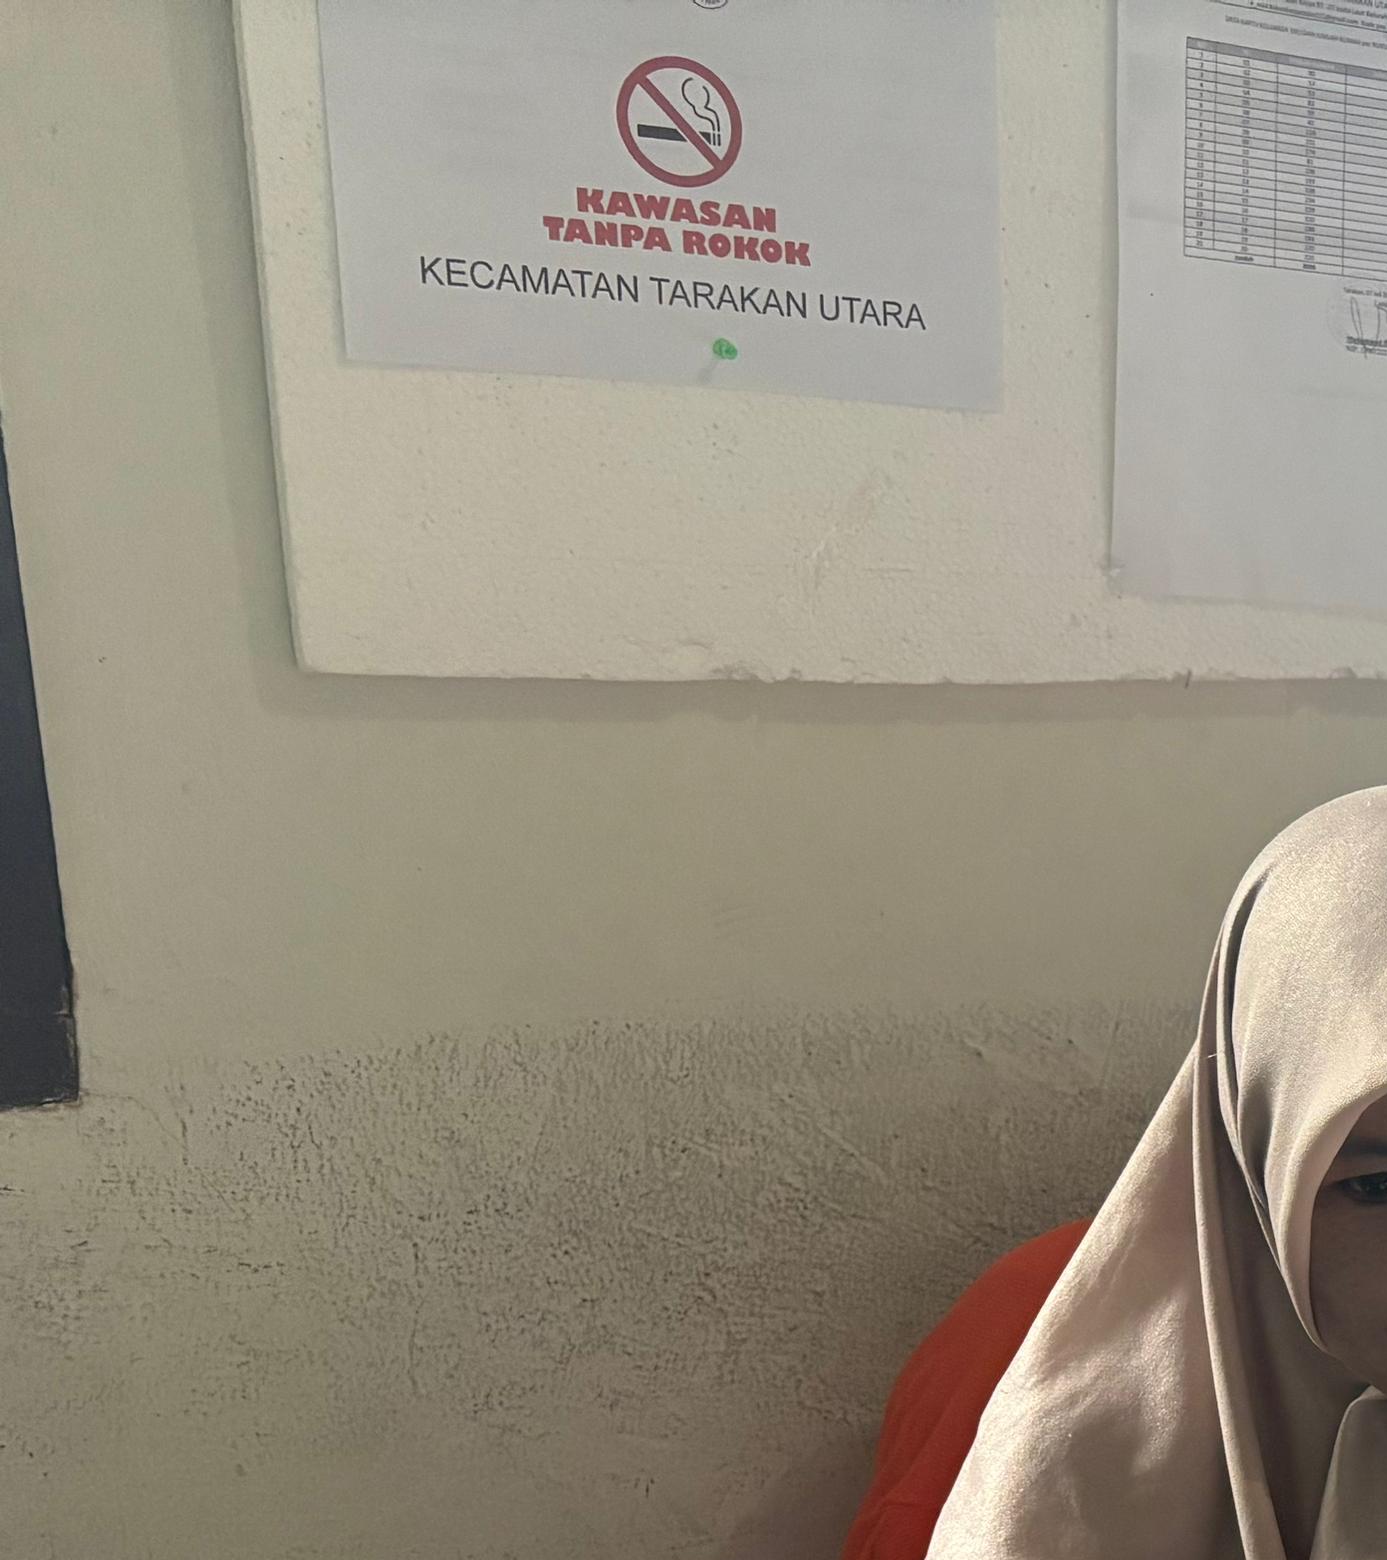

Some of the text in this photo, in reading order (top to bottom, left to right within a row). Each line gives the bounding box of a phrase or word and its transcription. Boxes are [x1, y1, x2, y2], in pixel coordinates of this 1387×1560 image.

[575, 187, 777, 233] KAWASAN
[542, 216, 812, 267] TANPA ROKOK
[418, 255, 928, 331] KECAMATAN TARAKAN UTARA
